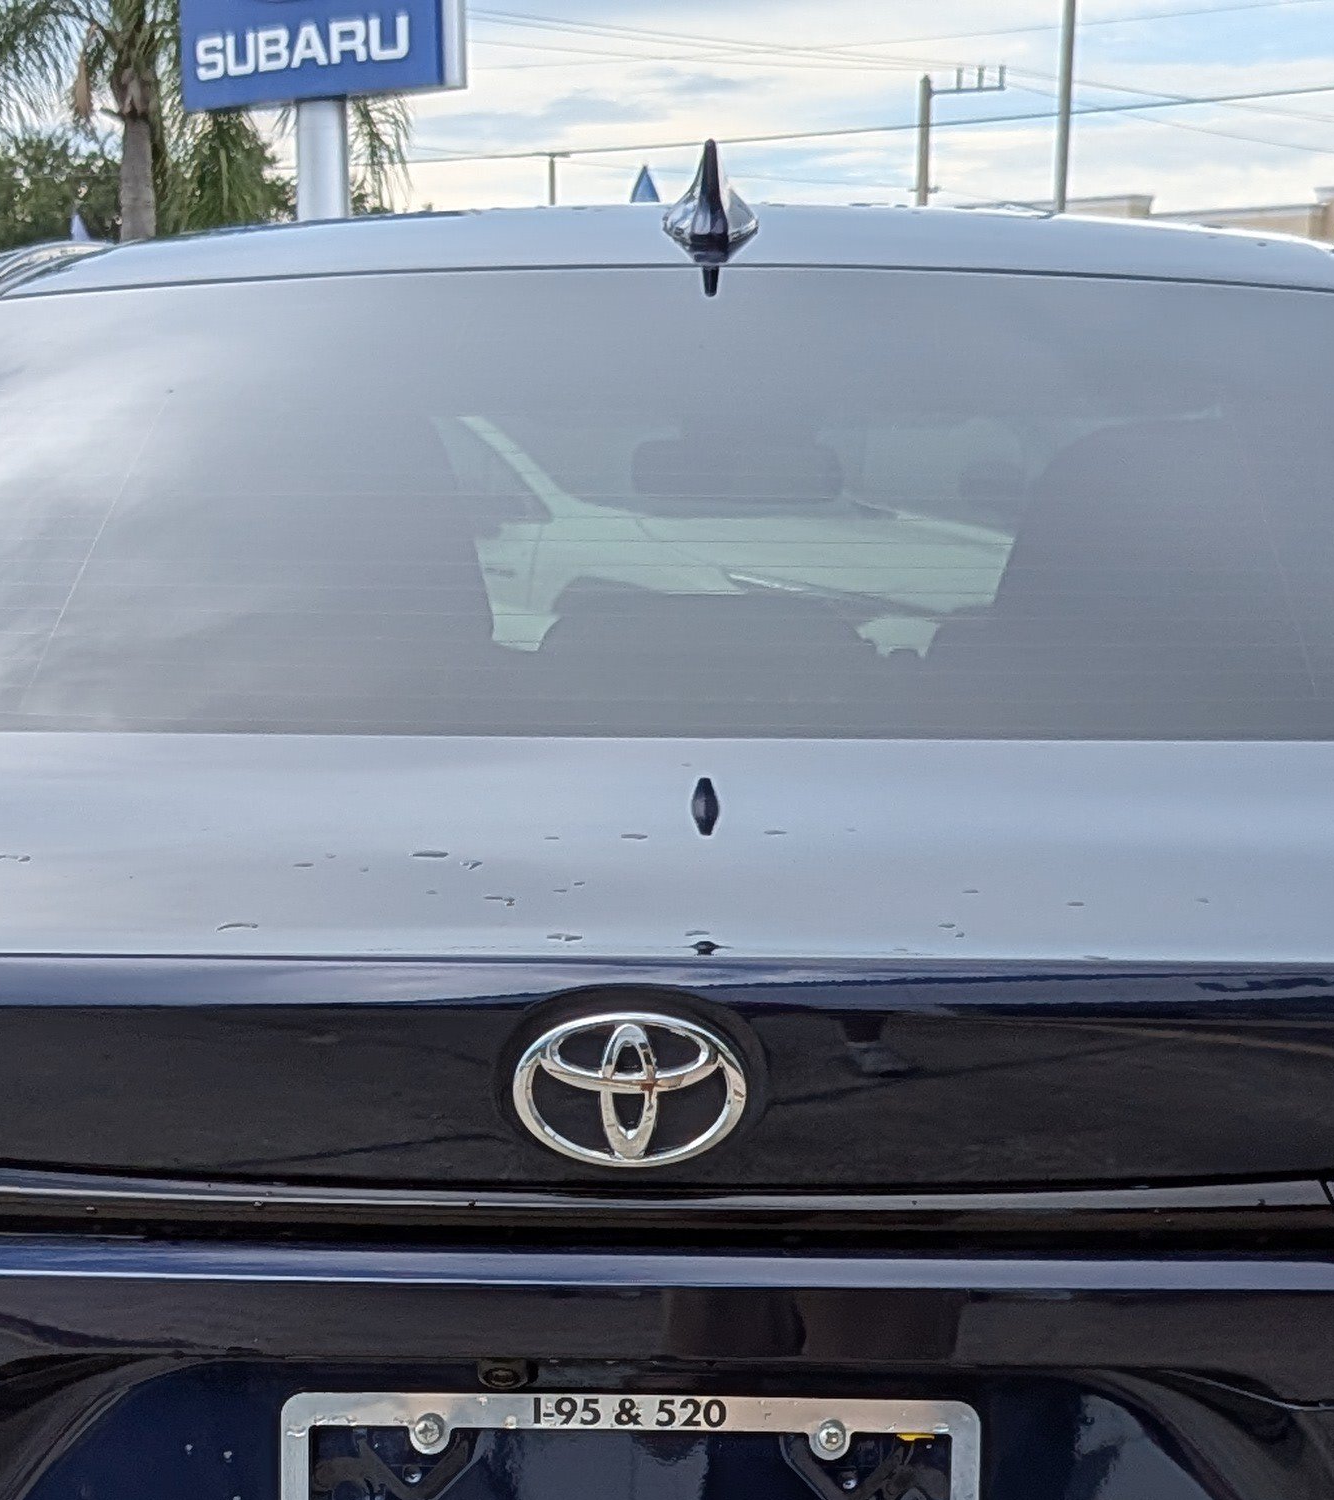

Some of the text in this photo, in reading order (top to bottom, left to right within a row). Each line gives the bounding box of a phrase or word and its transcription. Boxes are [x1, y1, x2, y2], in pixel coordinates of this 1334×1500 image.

[196, 12, 410, 81] SUBARU
[533, 1397, 727, 1427] I-95 & 520
